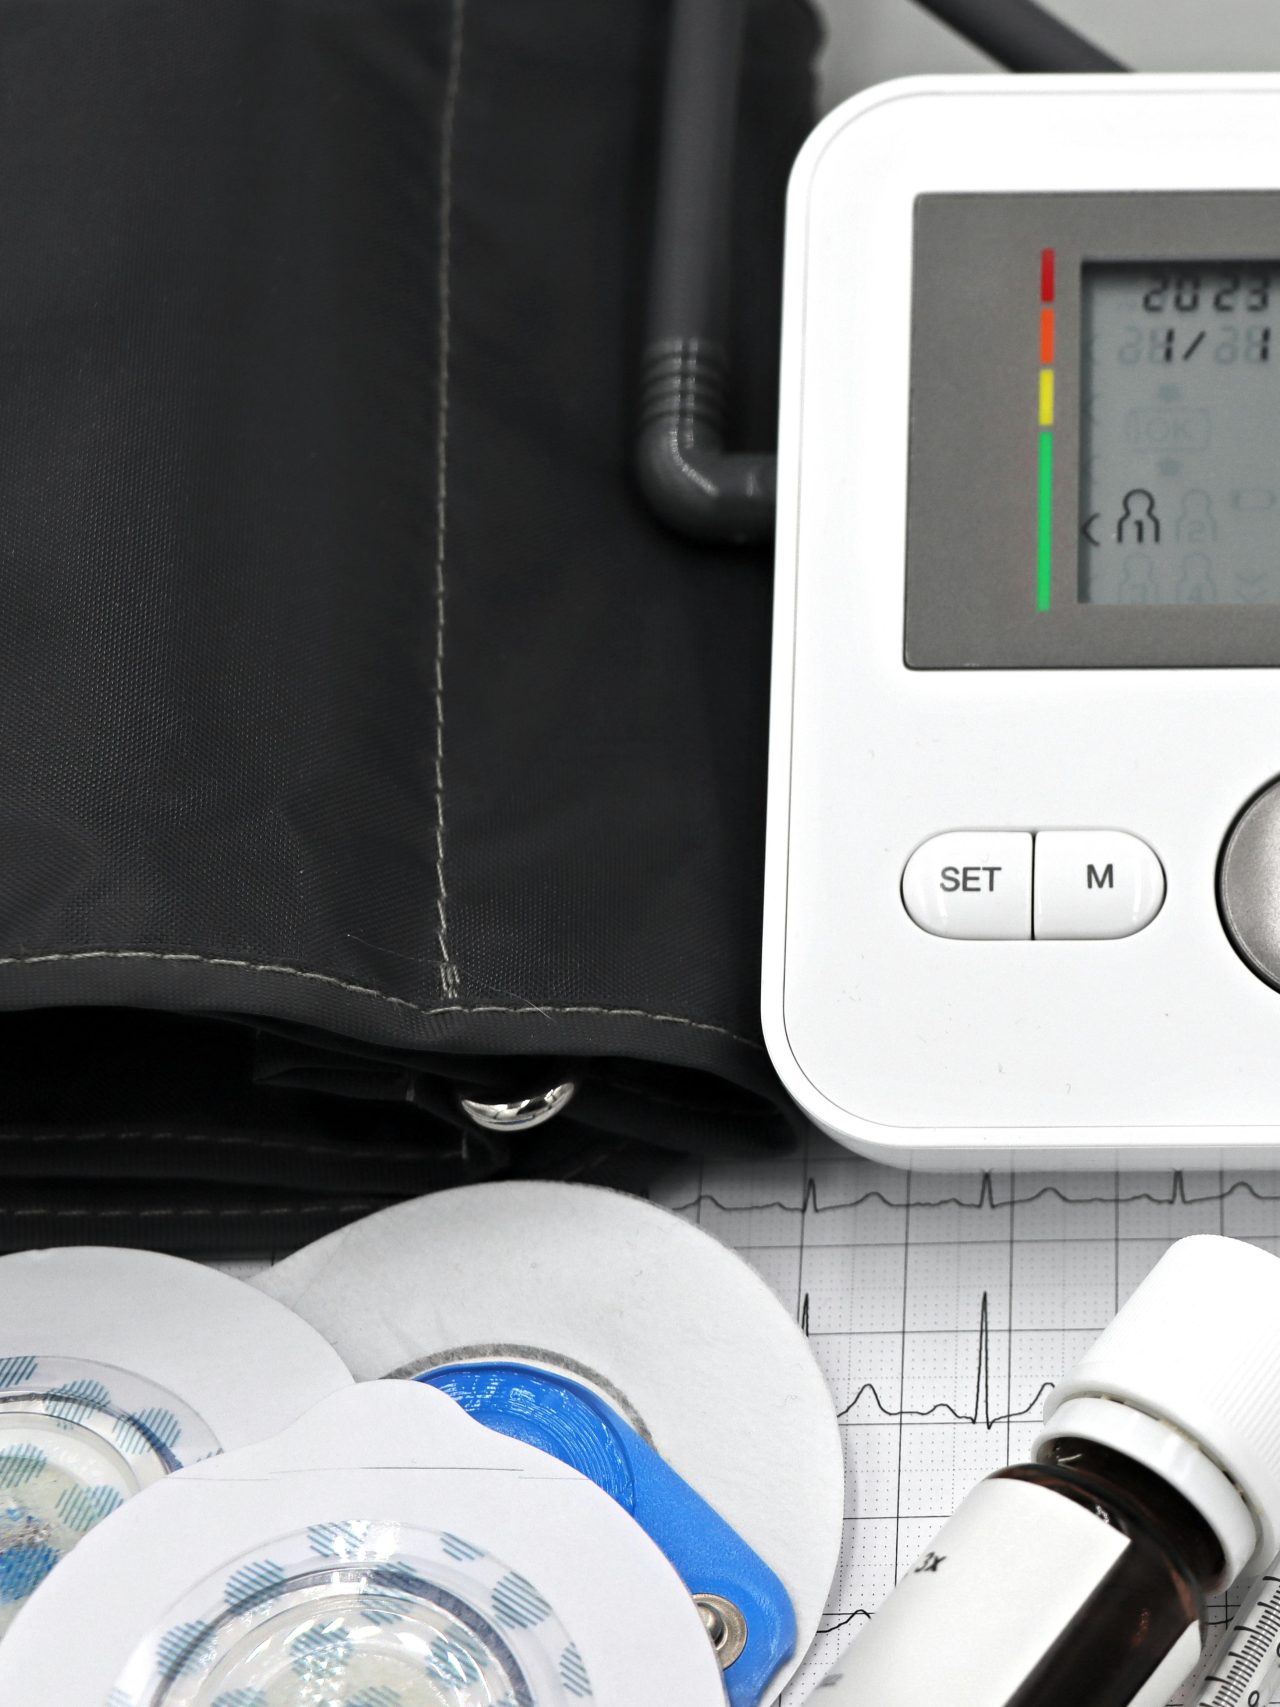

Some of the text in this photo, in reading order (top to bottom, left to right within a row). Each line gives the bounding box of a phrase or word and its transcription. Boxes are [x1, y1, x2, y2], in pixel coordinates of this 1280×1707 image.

[1142, 272, 1271, 313] 2023
[940, 866, 1002, 892] SET
[1086, 863, 1114, 889] M
